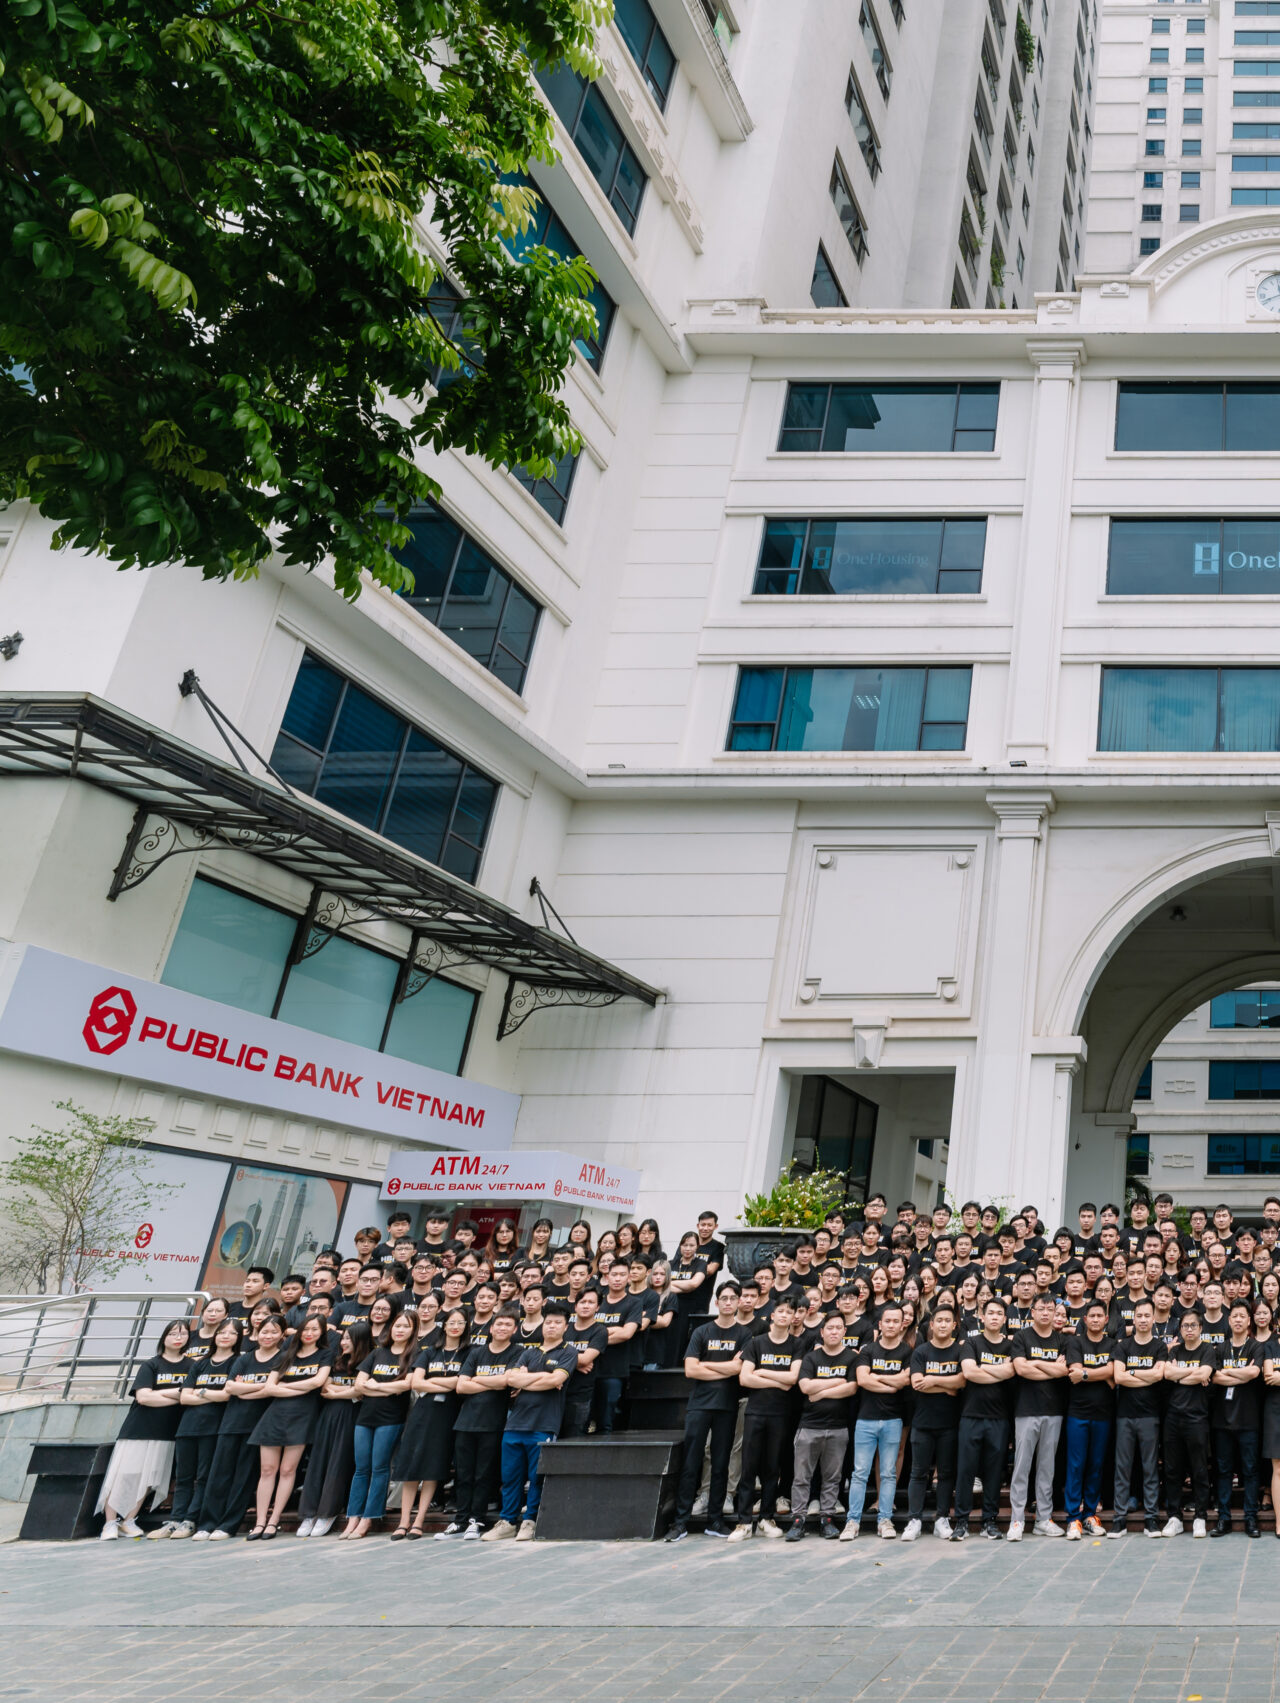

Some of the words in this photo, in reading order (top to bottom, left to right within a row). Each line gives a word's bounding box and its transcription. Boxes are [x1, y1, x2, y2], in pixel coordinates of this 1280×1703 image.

[138, 1016, 268, 1072] PUBLIC
[274, 1055, 364, 1098] BANK
[377, 1081, 485, 1128] VIETNAM
[430, 1156, 481, 1175] ATM
[481, 1164, 510, 1175] 24/7
[578, 1163, 606, 1186] ATM
[606, 1177, 621, 1189] 24/7
[403, 1183, 445, 1191] PUBLIC
[448, 1183, 483, 1191] BANK
[487, 1183, 546, 1191] VIETNAM
[563, 1186, 586, 1196] PUBLIC
[587, 1190, 605, 1201] BANK
[606, 1195, 634, 1206] VIETNAM
[118, 1250, 150, 1260] BANK
[153, 1253, 200, 1263] VIETNAM
[594, 1313, 621, 1323] HBLAB
[1200, 1333, 1225, 1343] HBLAB
[708, 1340, 736, 1351] HBLAB
[1031, 1347, 1058, 1359] HBLAB
[761, 1354, 792, 1366] HBLAB
[873, 1359, 902, 1371] HBLAB
[1127, 1356, 1153, 1367] HBLAB
[818, 1366, 847, 1377] HBLAB
[926, 1361, 958, 1373] HBLAB
